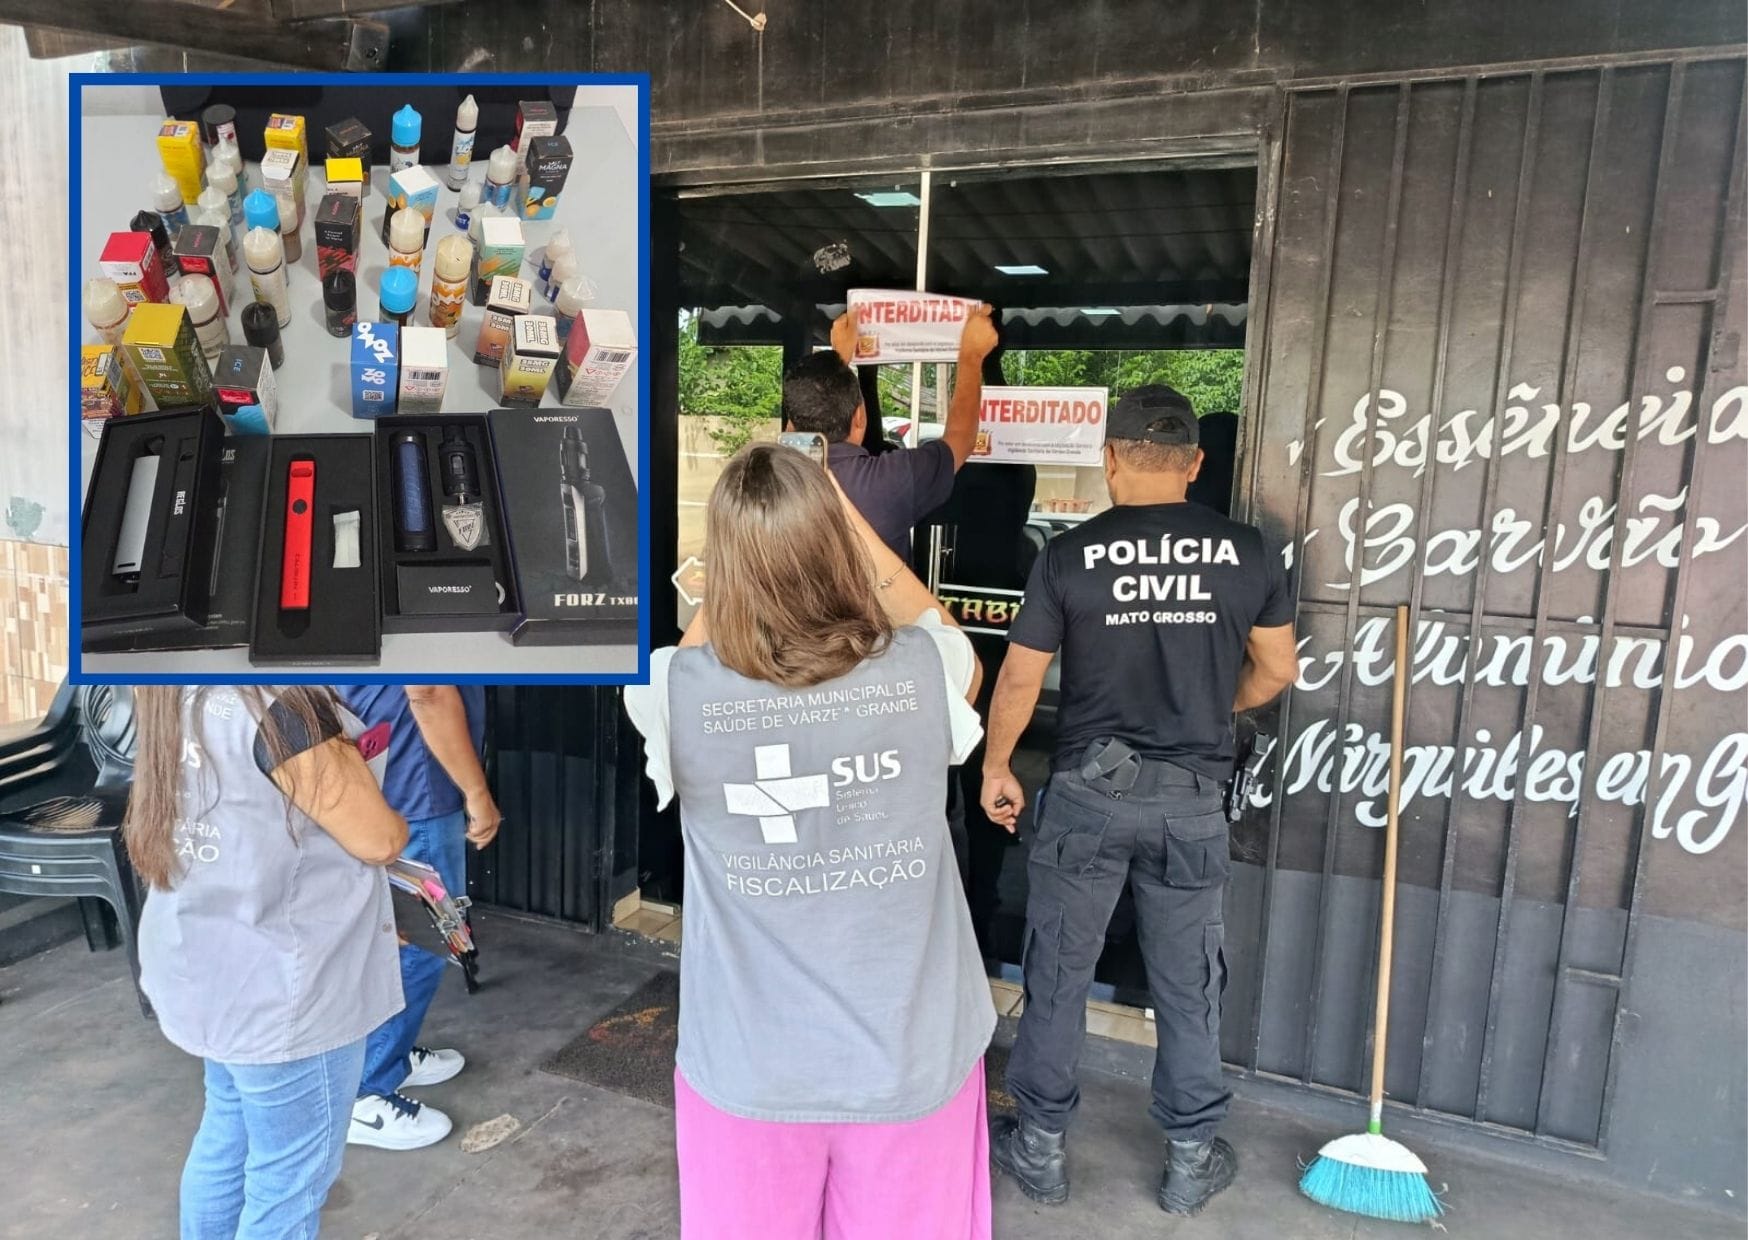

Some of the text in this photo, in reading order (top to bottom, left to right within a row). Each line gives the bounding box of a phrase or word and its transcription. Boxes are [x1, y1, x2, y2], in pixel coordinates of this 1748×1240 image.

[854, 299, 965, 325] NTERDITAD
[533, 415, 579, 424] VAPORESSO
[979, 399, 1102, 425] NTERDITADO
[1083, 533, 1240, 570] POLÍCIA
[1325, 485, 1747, 590] Carvão
[428, 585, 472, 594] VAPORESSO
[554, 593, 607, 607] FORZ
[1112, 574, 1212, 602] CIVIL
[1105, 611, 1217, 626] MATO GROSSO
[702, 680, 916, 717] SECRETARIA MUNICIPAL DE
[703, 697, 919, 735] SAÚDE DE VÁRZE GRANDE
[831, 749, 902, 787] SUS
[721, 836, 925, 872] VIGILÂNCIA SANITÁRIA
[727, 858, 927, 897] FISCALIZAÇÃO
